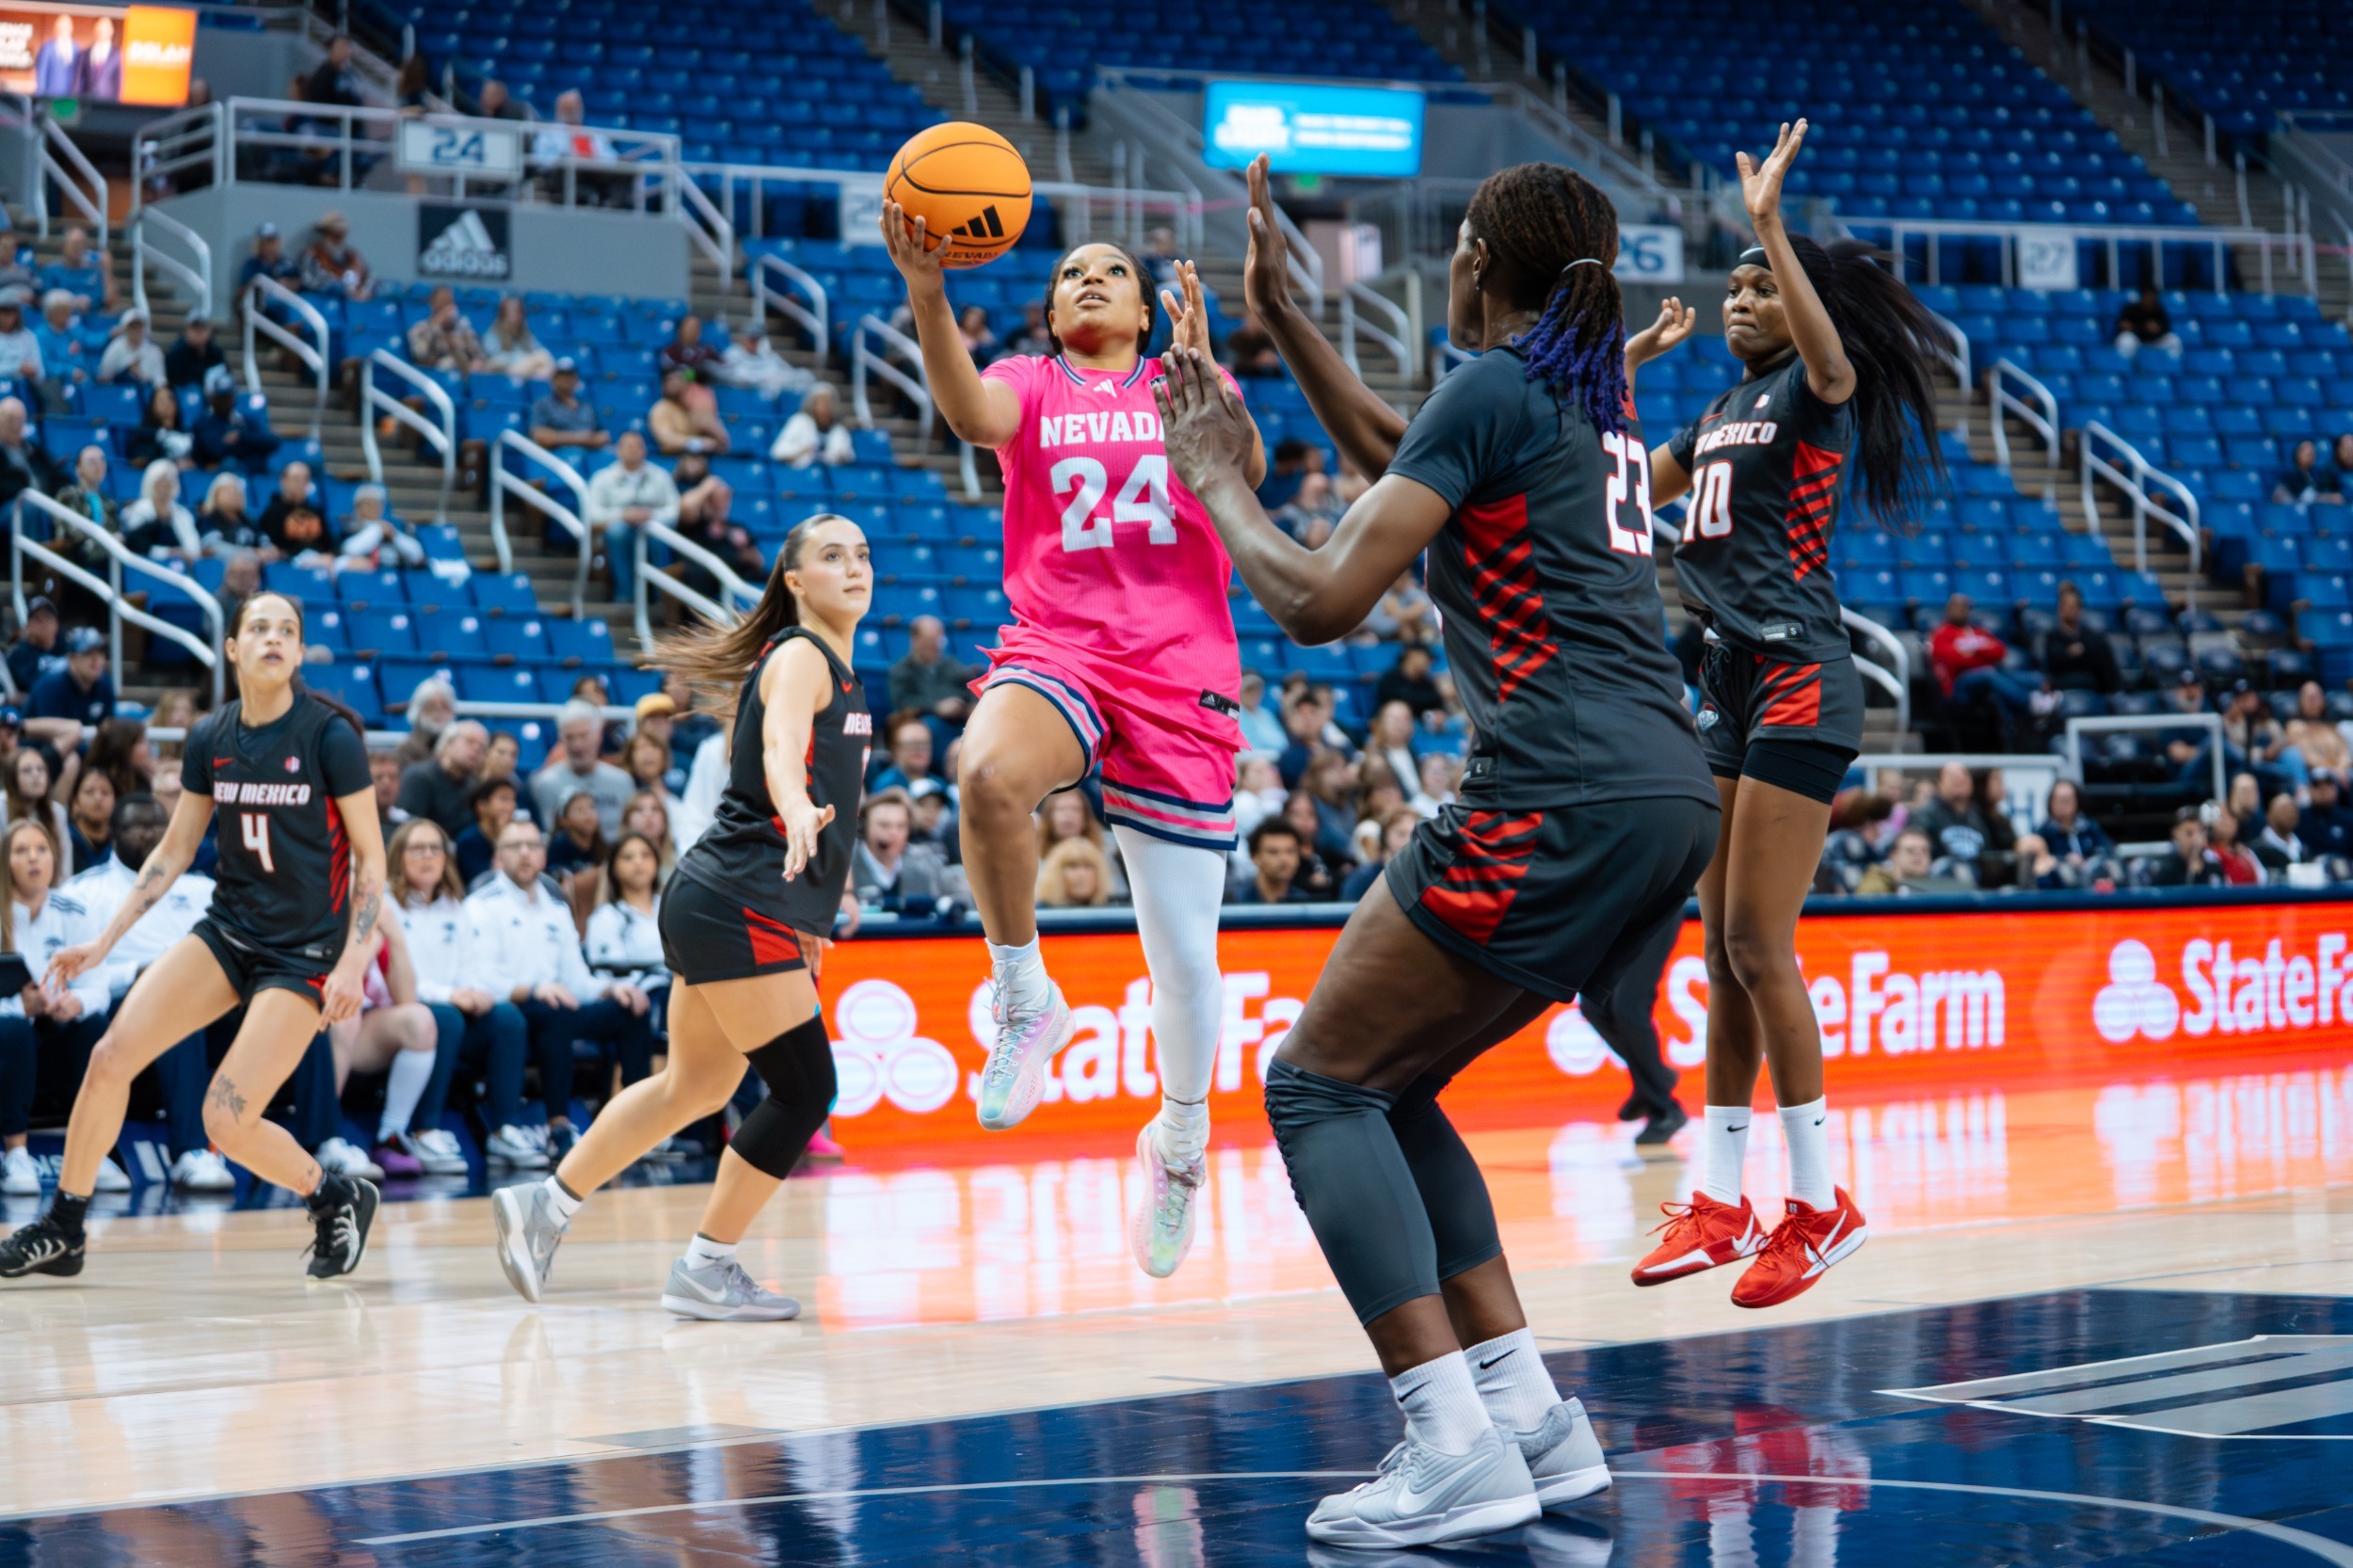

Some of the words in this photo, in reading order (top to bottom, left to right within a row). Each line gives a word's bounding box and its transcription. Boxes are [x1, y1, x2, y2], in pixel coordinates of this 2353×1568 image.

[432, 126, 486, 163] 24
[422, 248, 508, 275] adidas
[1050, 454, 1177, 553] 24
[1682, 458, 1734, 543] 10
[1790, 627, 1798, 635] S
[239, 782, 312, 807] MEXICO
[240, 811, 276, 873] 4
